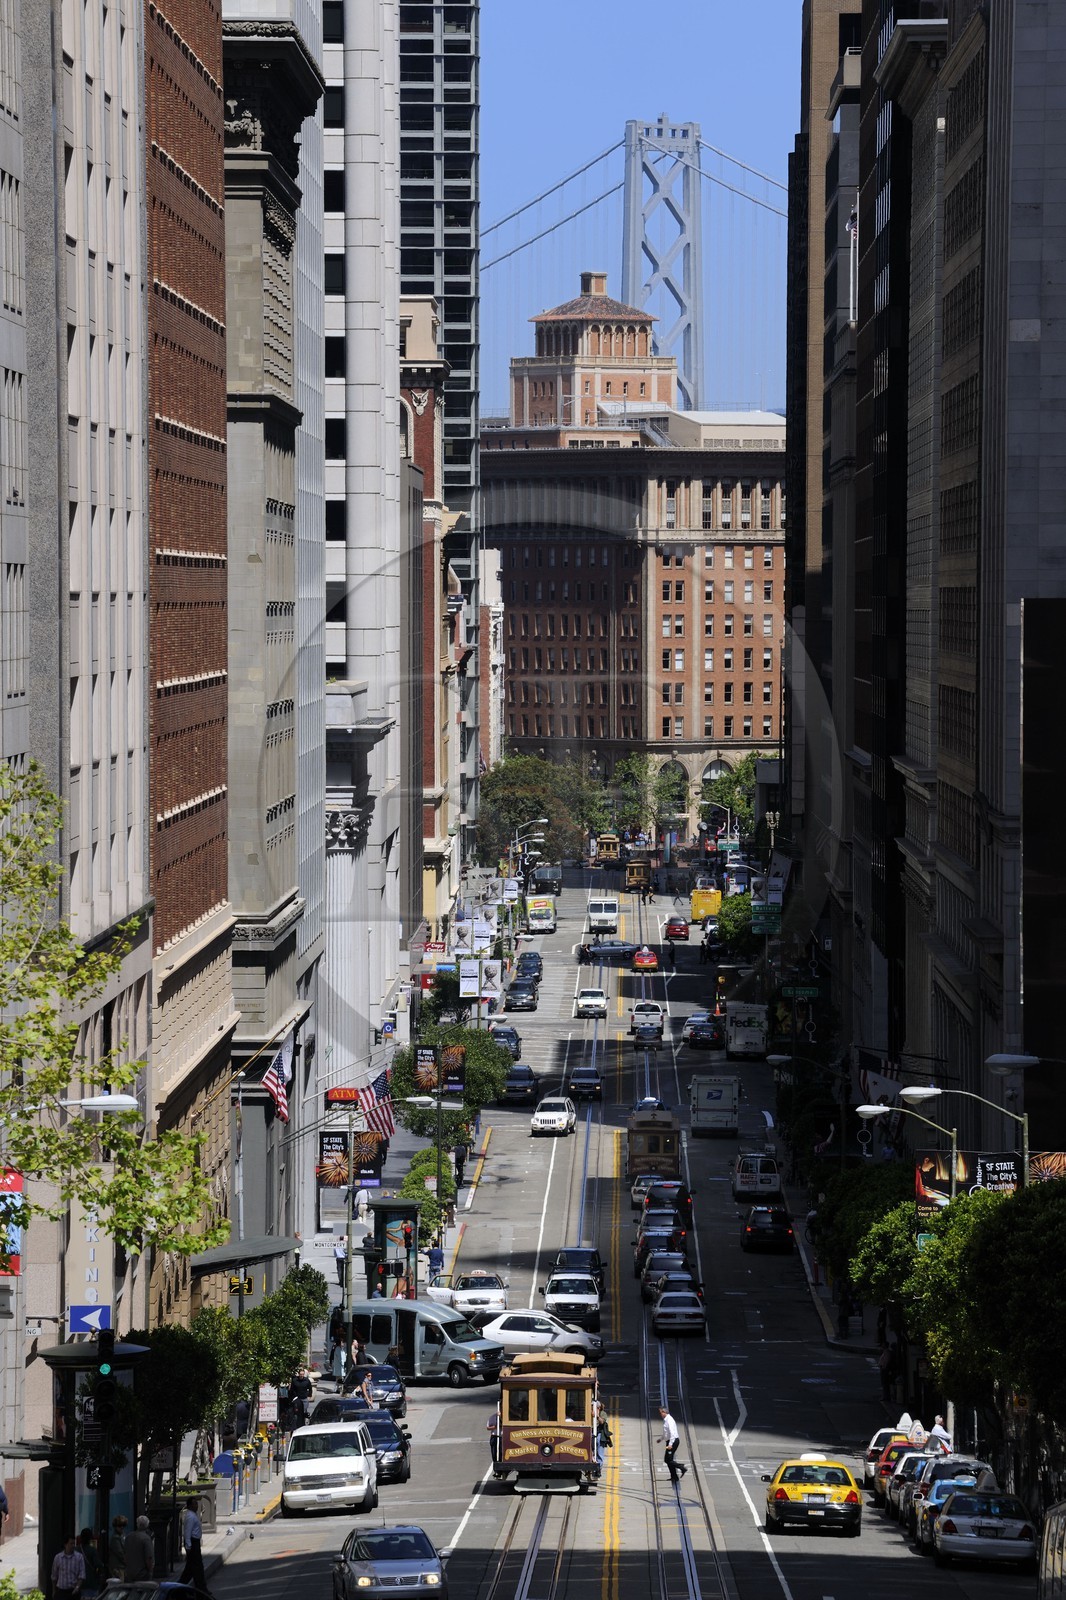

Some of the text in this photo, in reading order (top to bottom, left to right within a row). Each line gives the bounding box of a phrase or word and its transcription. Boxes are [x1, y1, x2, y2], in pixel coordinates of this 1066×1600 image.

[729, 1016, 764, 1028] FedEx
[331, 1090, 356, 1098] ATM
[985, 1161, 1015, 1171] SF STATE
[999, 1171, 1018, 1181] City's
[986, 1182, 1015, 1191] Creative
[84, 1207, 99, 1304] RKING
[554, 1429, 584, 1439] California
[514, 1446, 536, 1455] Market
[560, 1445, 584, 1455] Streets
